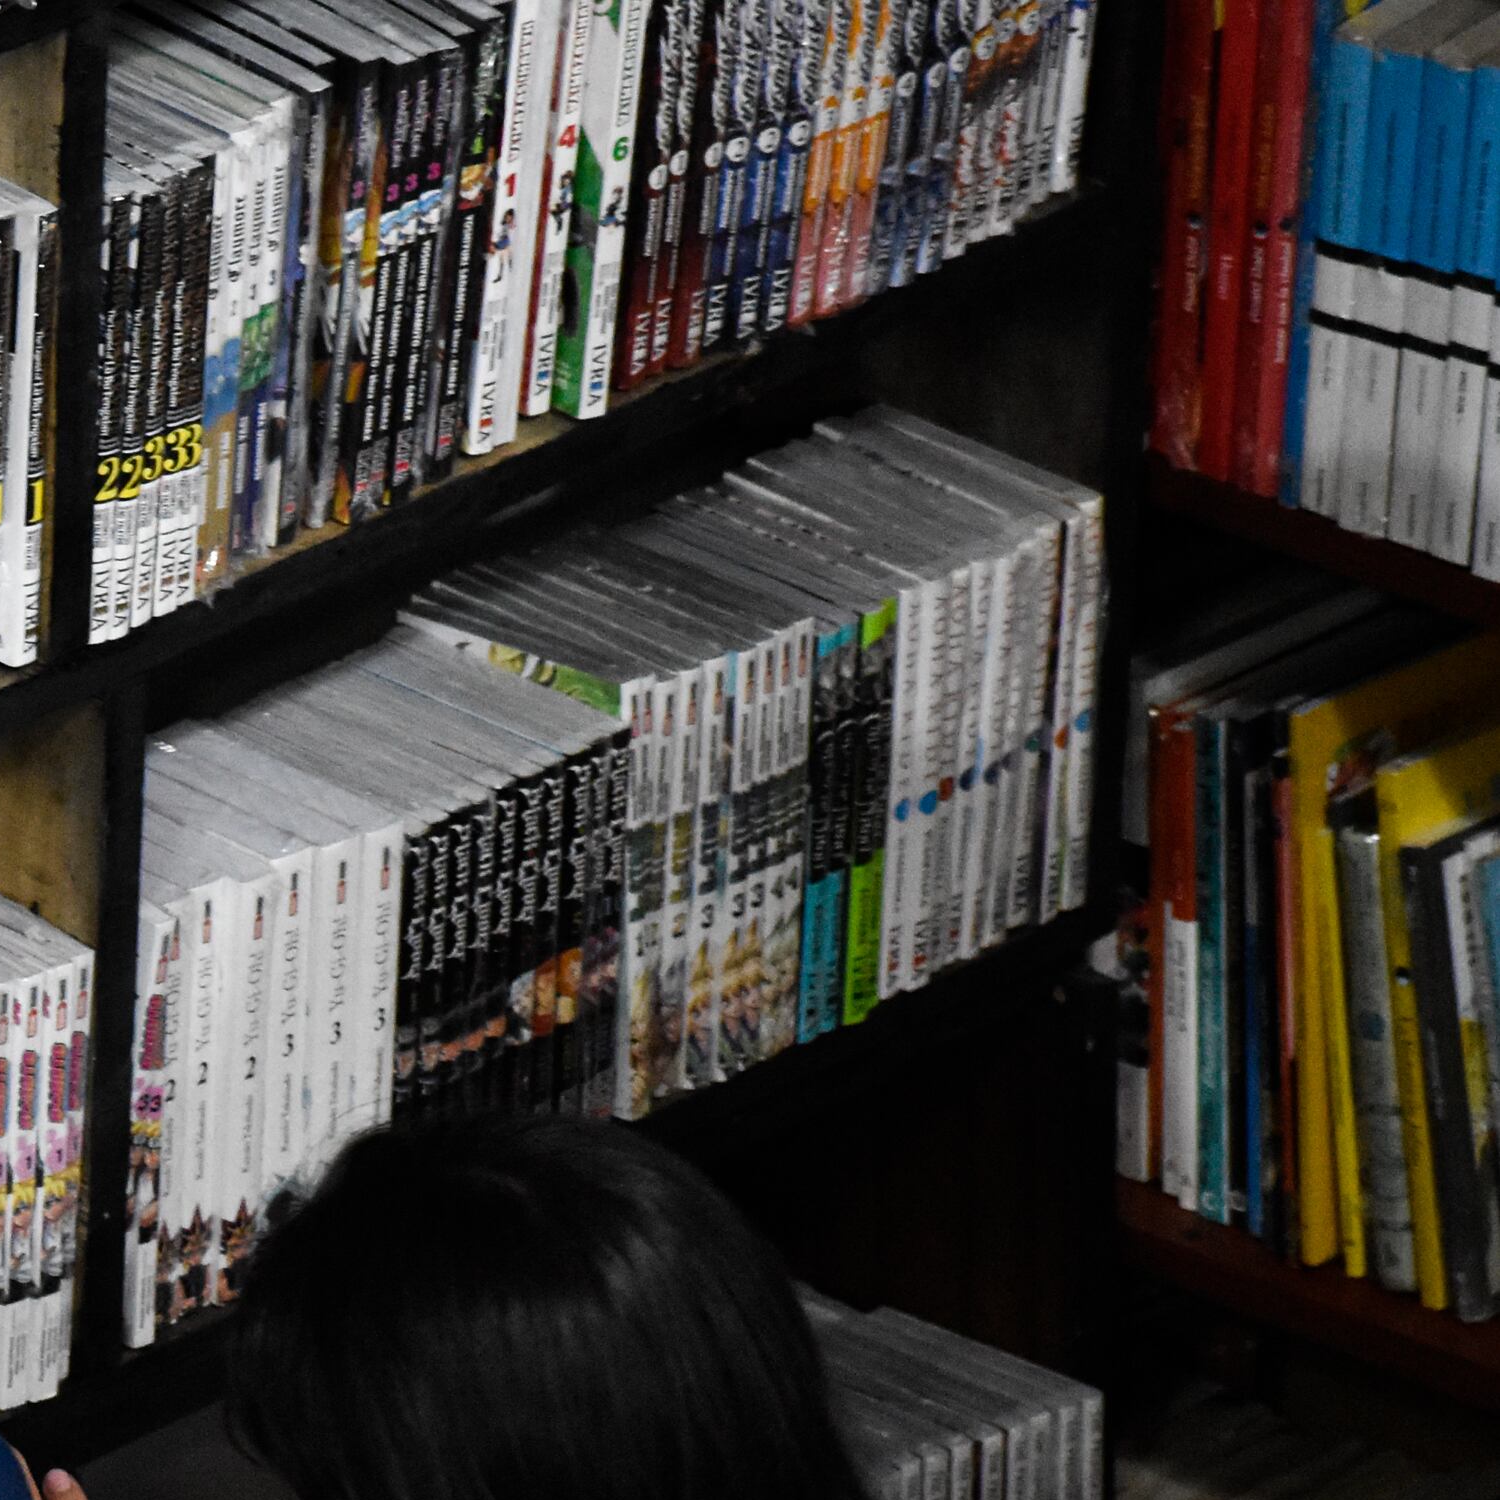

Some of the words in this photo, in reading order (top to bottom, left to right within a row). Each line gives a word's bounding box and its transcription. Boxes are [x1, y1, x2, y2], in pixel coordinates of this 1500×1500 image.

[557, 124, 578, 149] 4
[612, 136, 630, 163] 6
[503, 172, 517, 199] 1
[533, 332, 555, 398] IVREA
[587, 343, 608, 409] IVREA
[477, 382, 498, 447] IVREA
[95, 457, 120, 502] 2
[118, 454, 143, 499] 2
[143, 436, 164, 480] 3
[91, 568, 110, 633] IVREA
[113, 565, 132, 629] IVREA
[282, 1033, 294, 1058] 3
[330, 1021, 341, 1045] 3
[245, 1055, 257, 1081] 2
